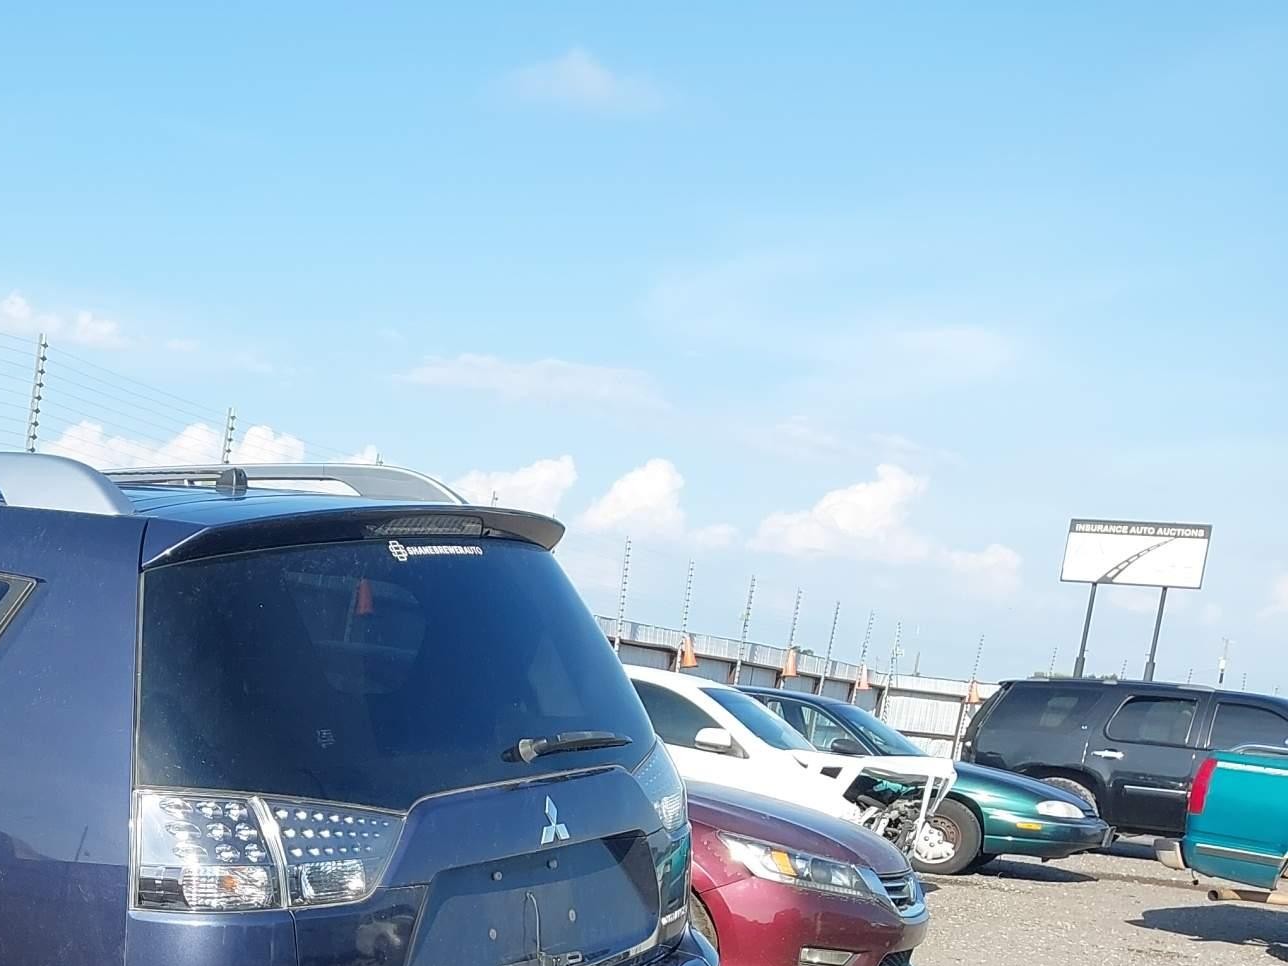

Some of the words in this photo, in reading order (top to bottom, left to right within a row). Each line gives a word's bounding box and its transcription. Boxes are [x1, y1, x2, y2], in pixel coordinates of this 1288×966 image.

[1075, 523, 1129, 534] INSURANCE
[1129, 526, 1155, 536] AUTO
[1156, 527, 1205, 538] AUCTIONS
